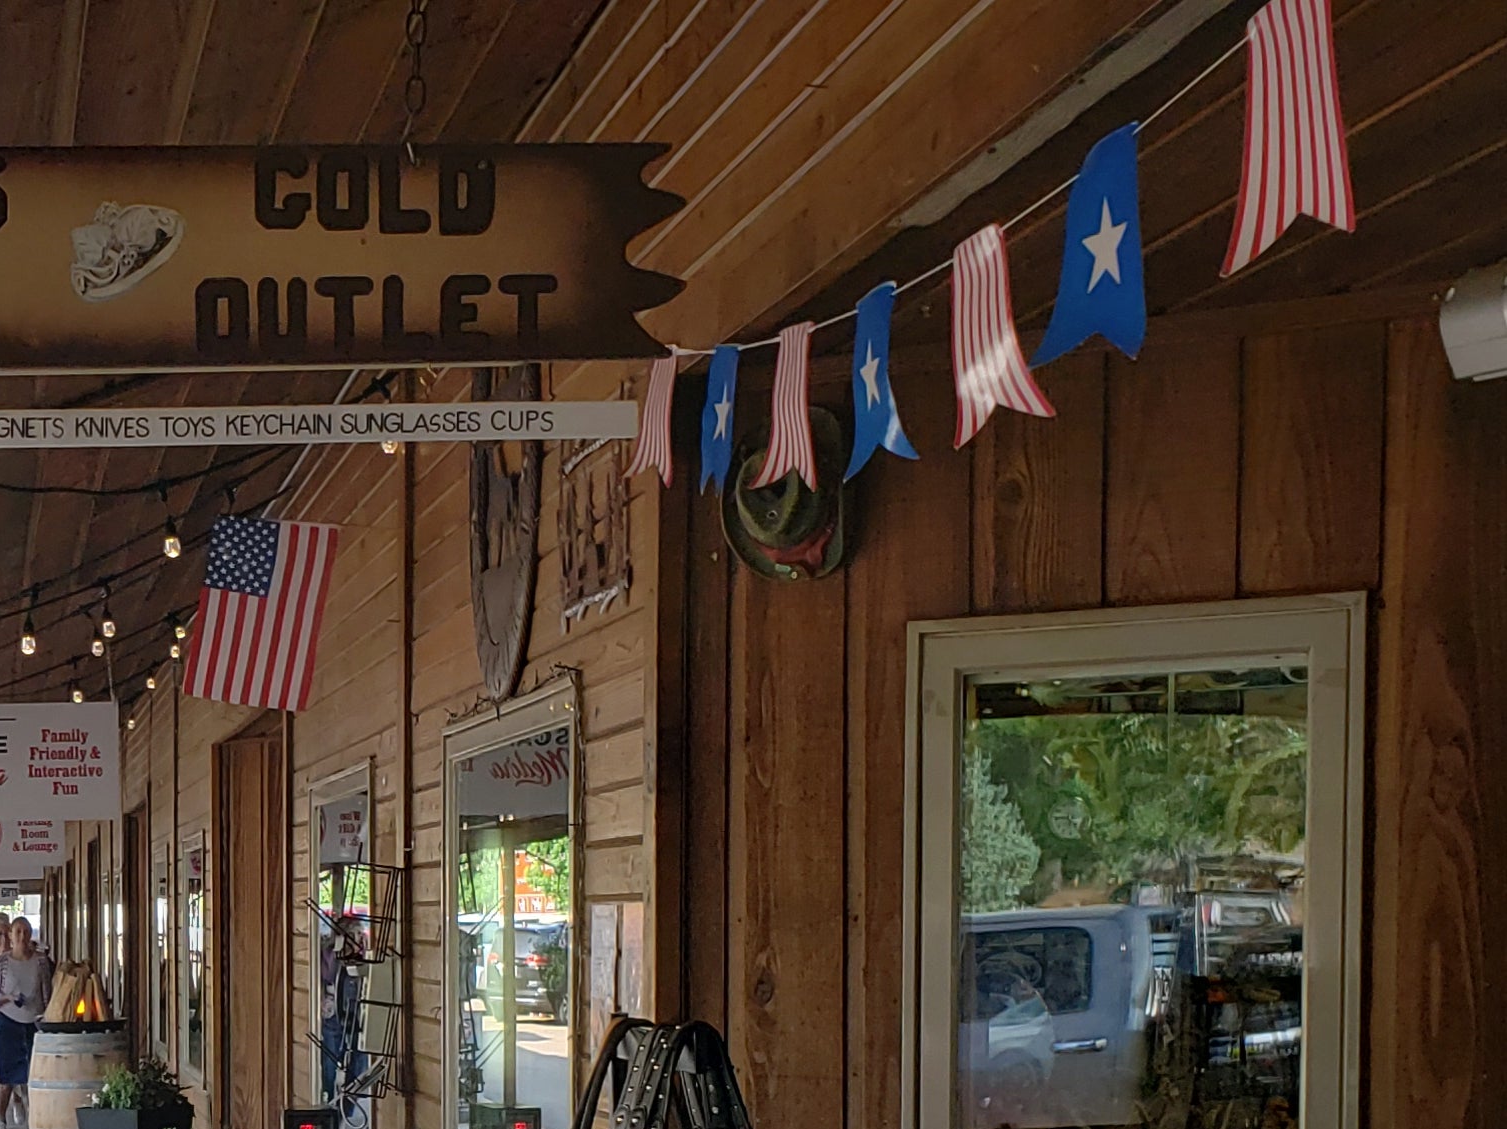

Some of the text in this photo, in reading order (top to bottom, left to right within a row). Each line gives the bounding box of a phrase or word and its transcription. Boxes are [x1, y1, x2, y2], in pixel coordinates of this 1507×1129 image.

[253, 150, 495, 236] GOLD
[195, 273, 559, 354] OUTLET
[74, 416, 151, 439] KNIVES
[159, 415, 216, 438] TOYS
[225, 412, 333, 436] KEYCHAIN
[339, 410, 482, 435] SUNGLASSES
[490, 409, 555, 433] CUPS
[41, 729, 89, 745] Family
[30, 746, 101, 762] Friendly &
[28, 764, 103, 778] Interactive
[52, 781, 79, 795] Fun
[20, 828, 49, 839] Room
[22, 841, 59, 853] Lounge
